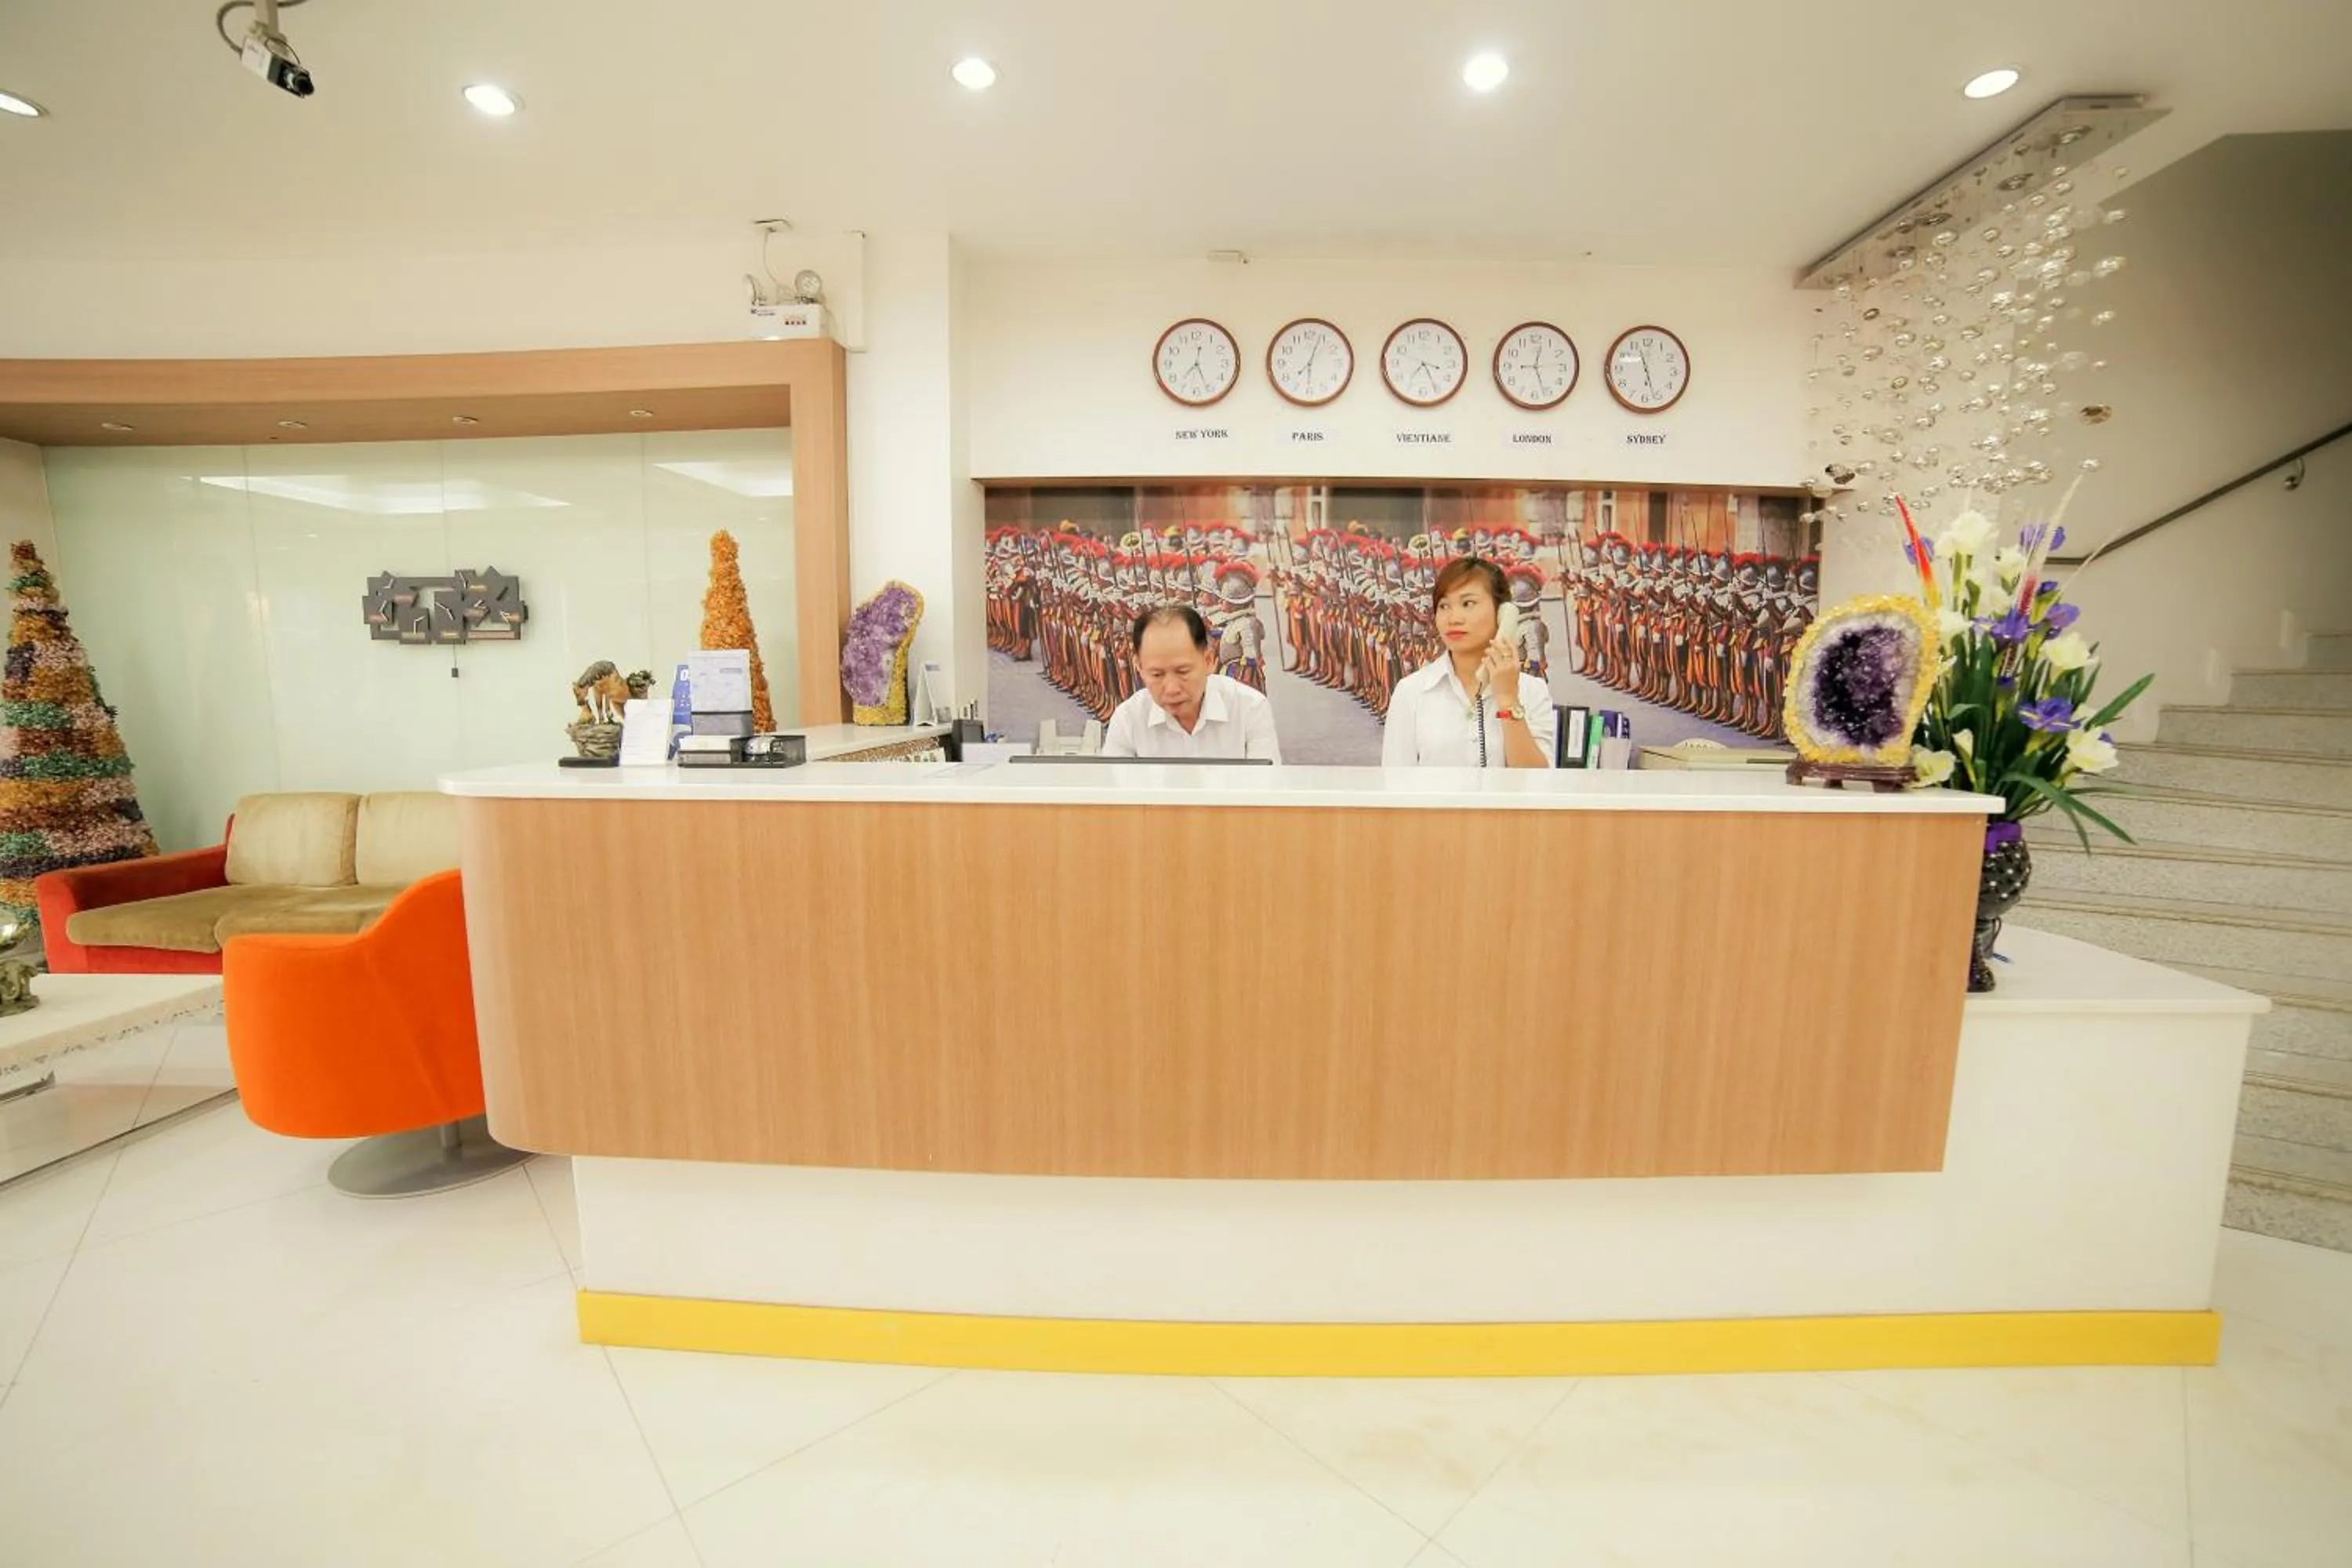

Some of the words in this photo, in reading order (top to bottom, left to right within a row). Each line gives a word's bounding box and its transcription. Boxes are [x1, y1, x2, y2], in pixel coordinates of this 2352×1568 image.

[1176, 430, 1198, 439] NEW
[1200, 429, 1229, 439] YORK
[1292, 432, 1324, 441] PARIS
[1513, 434, 1552, 443] LONDON
[1626, 434, 1666, 444] SYDNEY
